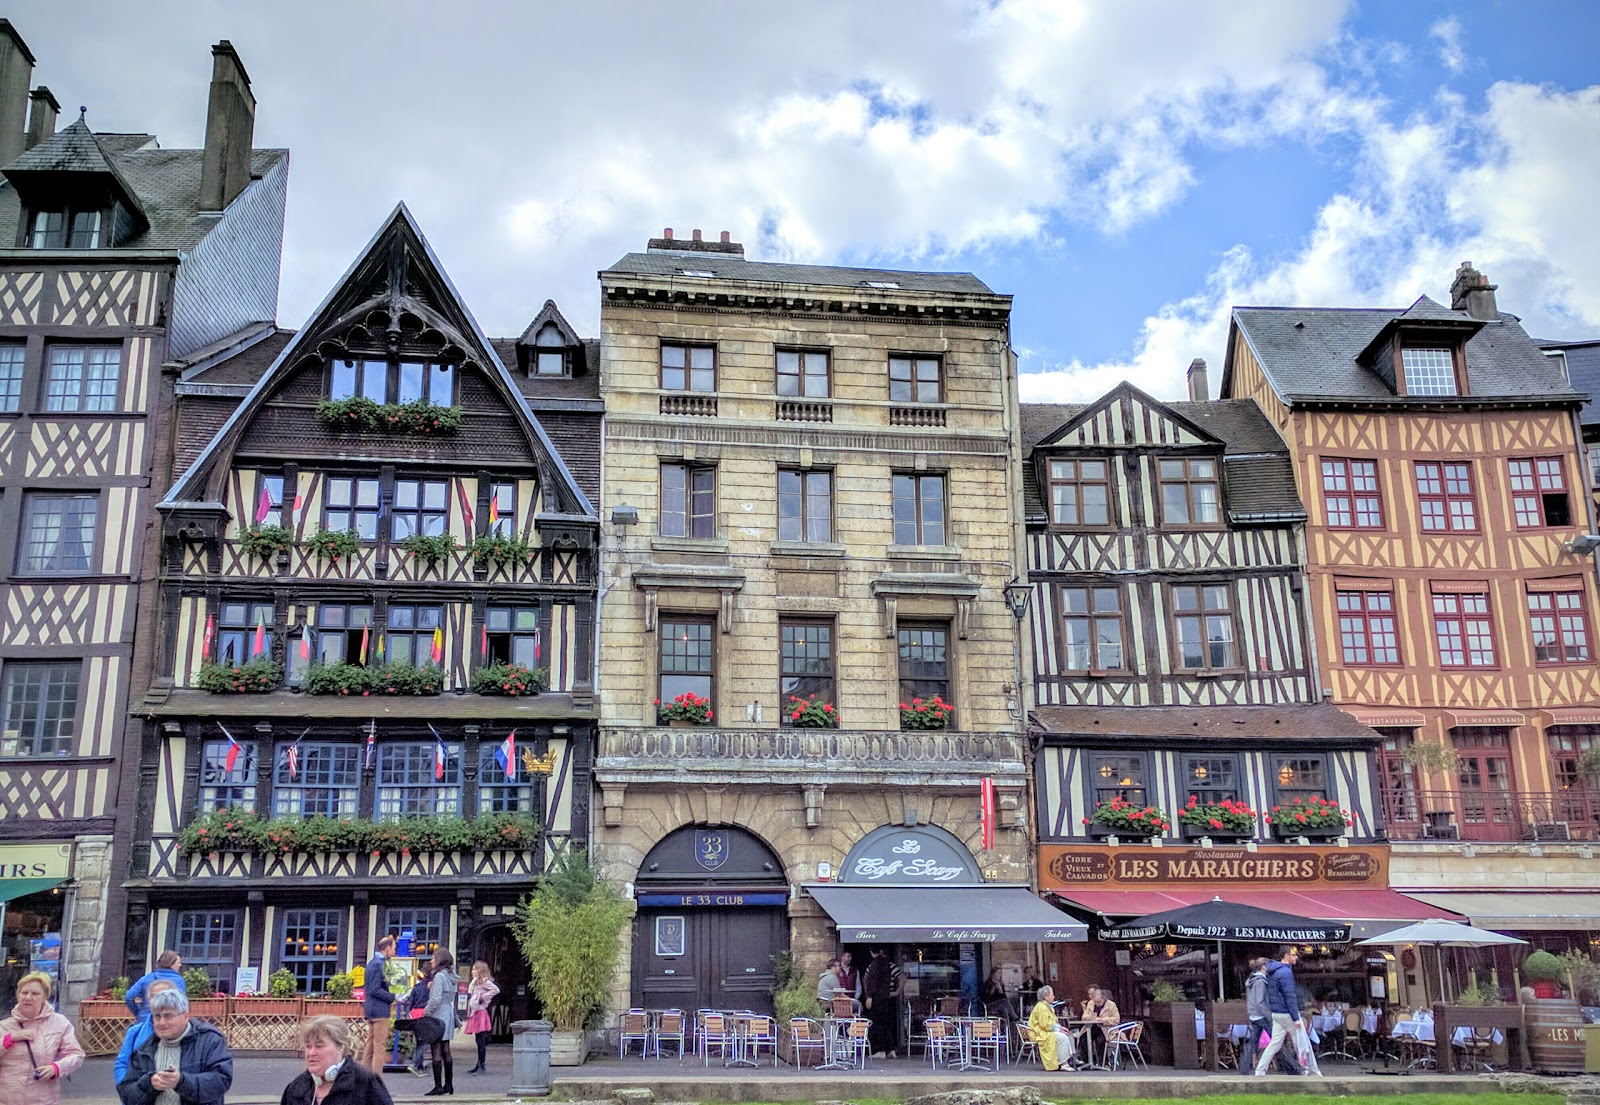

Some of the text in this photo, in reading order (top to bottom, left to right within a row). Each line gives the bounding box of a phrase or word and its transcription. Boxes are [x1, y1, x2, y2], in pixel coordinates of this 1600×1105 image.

[701, 836, 722, 854] 33
[892, 839, 921, 854] Le
[1065, 855, 1092, 863] CIDRE
[1194, 851, 1244, 859] Restaurant
[1065, 864, 1092, 872] VIEUX
[1119, 859, 1314, 878] LES MARAICHERS
[1327, 868, 1367, 877] BEAUJOLAIS
[1065, 872, 1108, 880] CALVADOS
[681, 895, 744, 905] LE 33 CLUB
[855, 930, 878, 939] Bar
[932, 930, 945, 939] Le
[946, 930, 969, 941] Café
[1044, 929, 1073, 939] Tabac
[1176, 924, 1345, 940] Depuis 1912 LES MARAICHERS 37
[1551, 1028, 1569, 1042] LES
